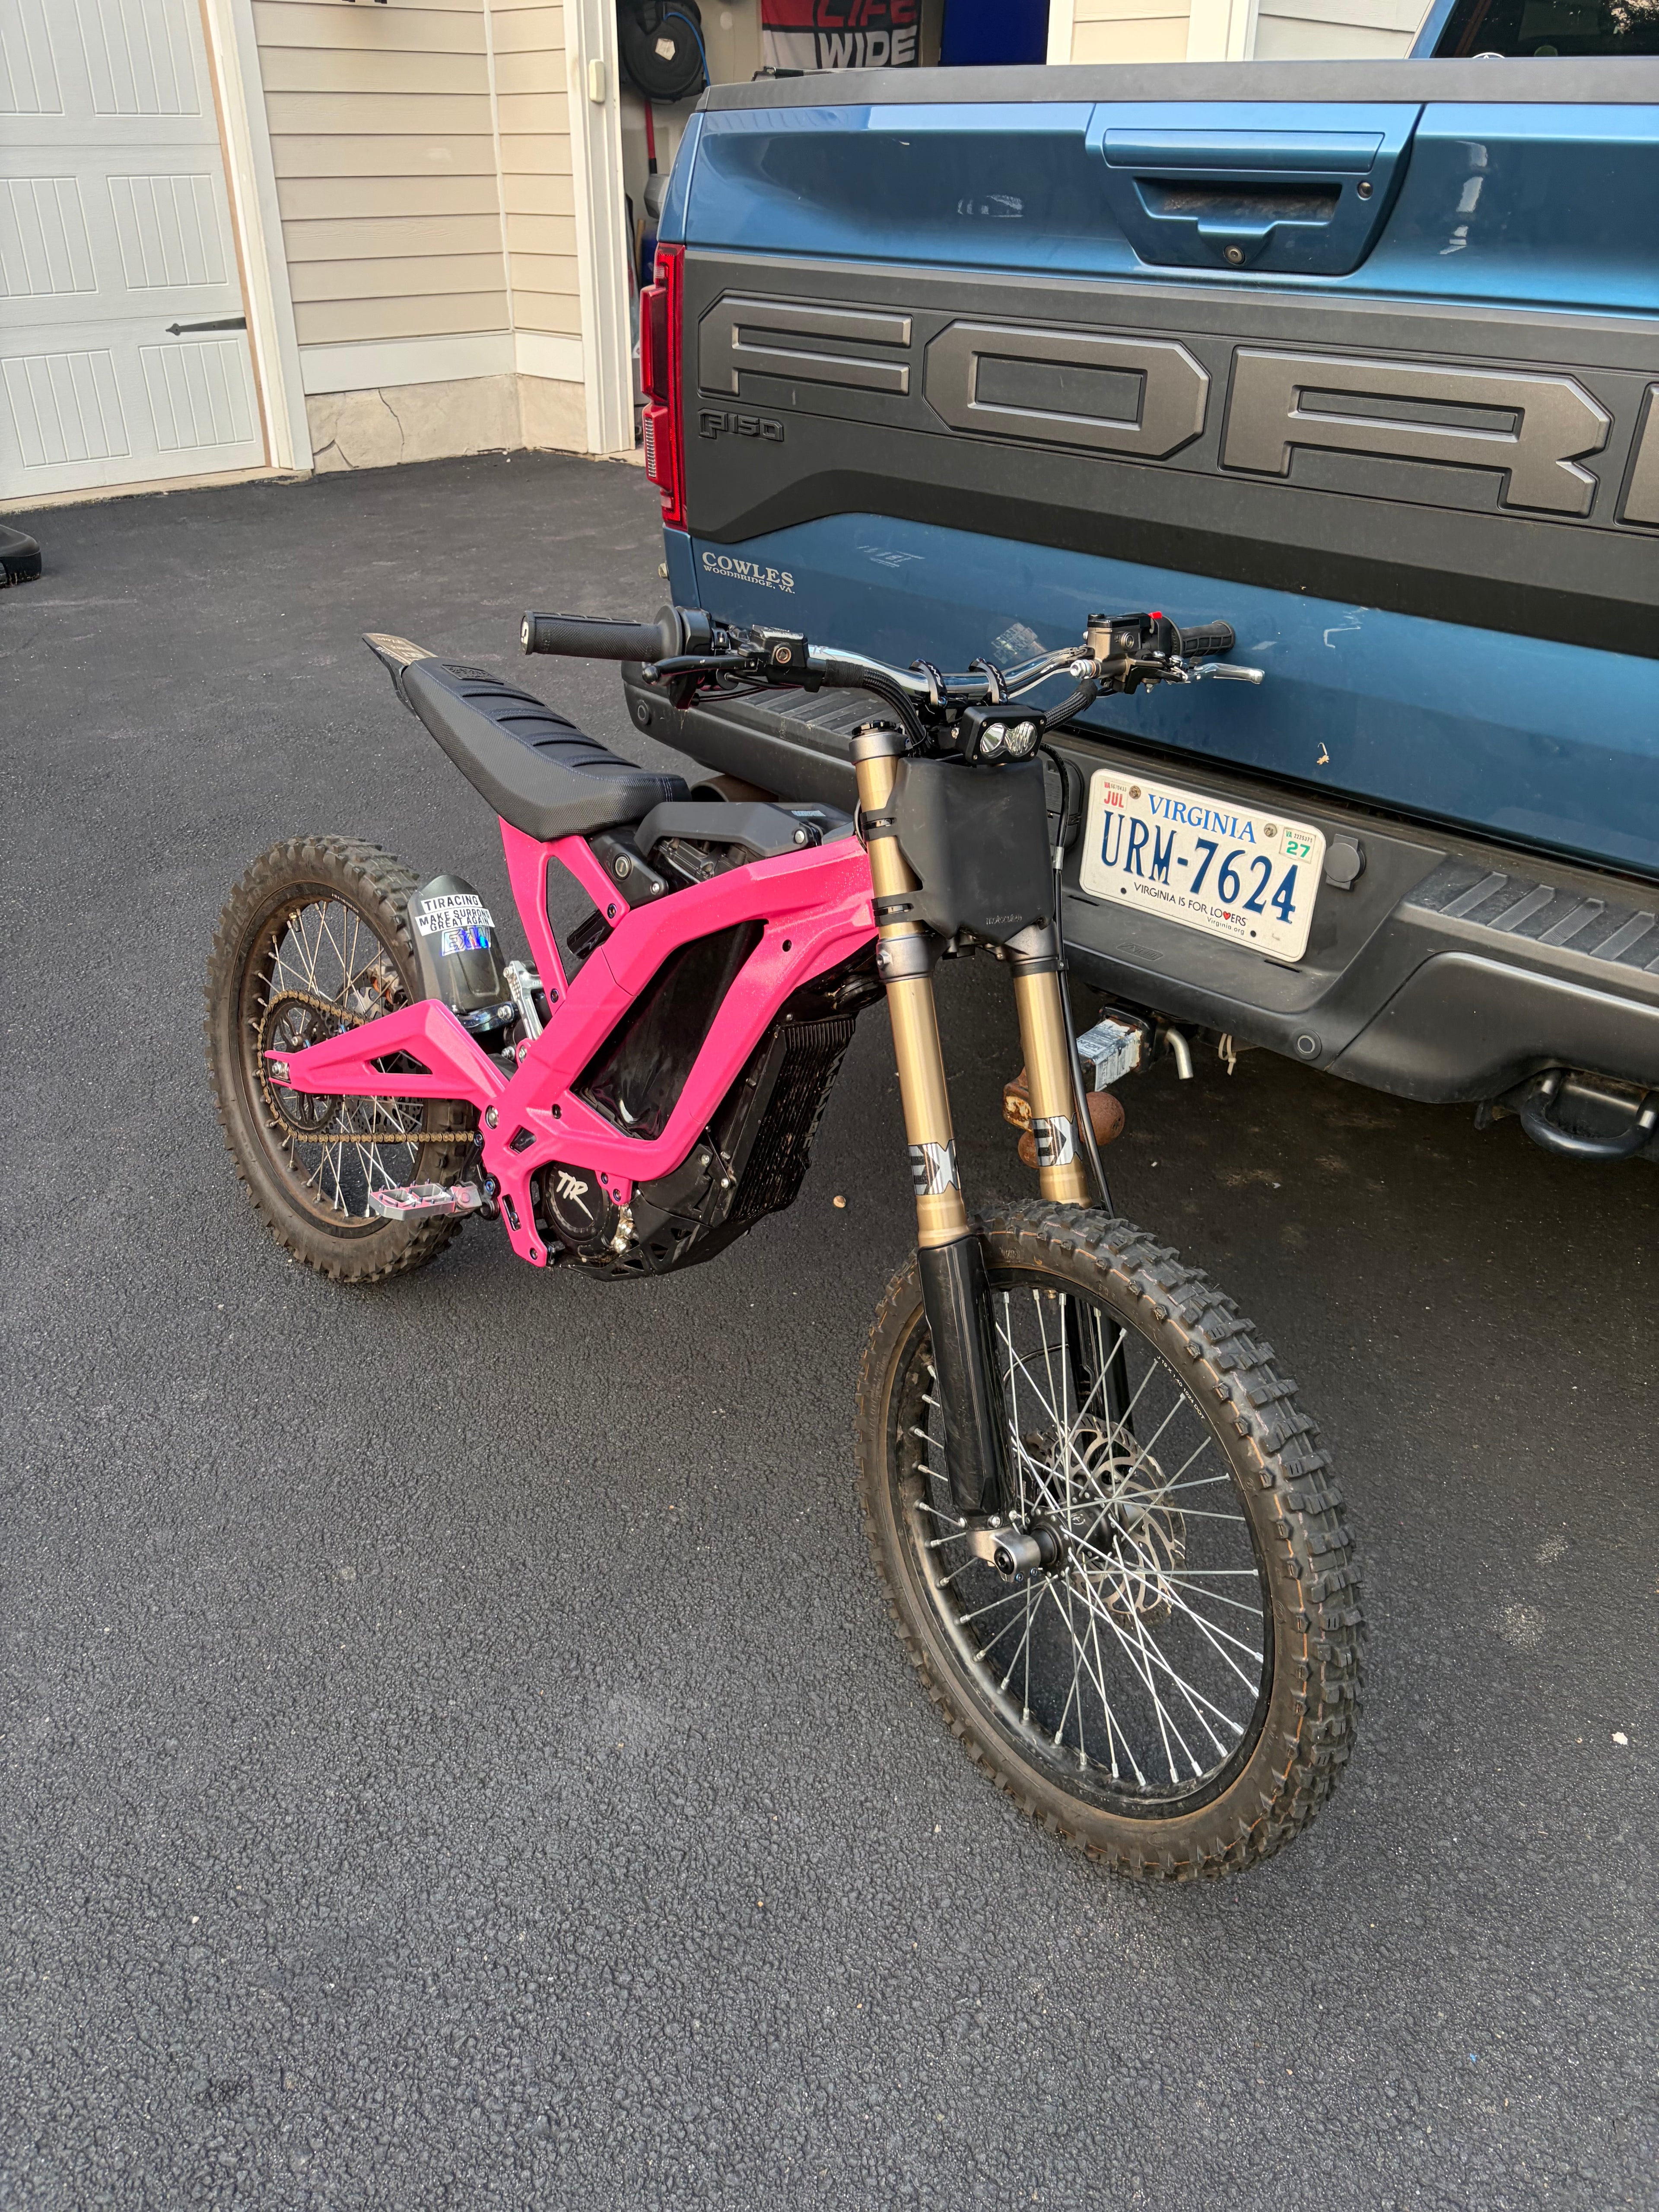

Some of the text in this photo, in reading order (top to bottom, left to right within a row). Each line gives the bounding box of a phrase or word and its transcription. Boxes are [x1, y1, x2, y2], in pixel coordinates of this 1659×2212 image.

[818, 25, 917, 69] WIDE
[698, 289, 1659, 526] FOR
[702, 552, 795, 588] COWLES
[1104, 791, 1124, 808] JUL
[1148, 793, 1256, 844] VIRGINIA
[1286, 830, 1292, 838] VA
[1287, 840, 1310, 858] 27
[1101, 810, 1298, 924] URM-7624
[424, 896, 479, 911] TIRACING
[1134, 882, 1176, 904] VIRGINIA
[1179, 896, 1185, 906] IS
[1188, 900, 1207, 914] FOR
[419, 912, 451, 926] MAKE
[430, 915, 489, 931] GREAT AGAIN
[1194, 1404, 1205, 1419] DOT
